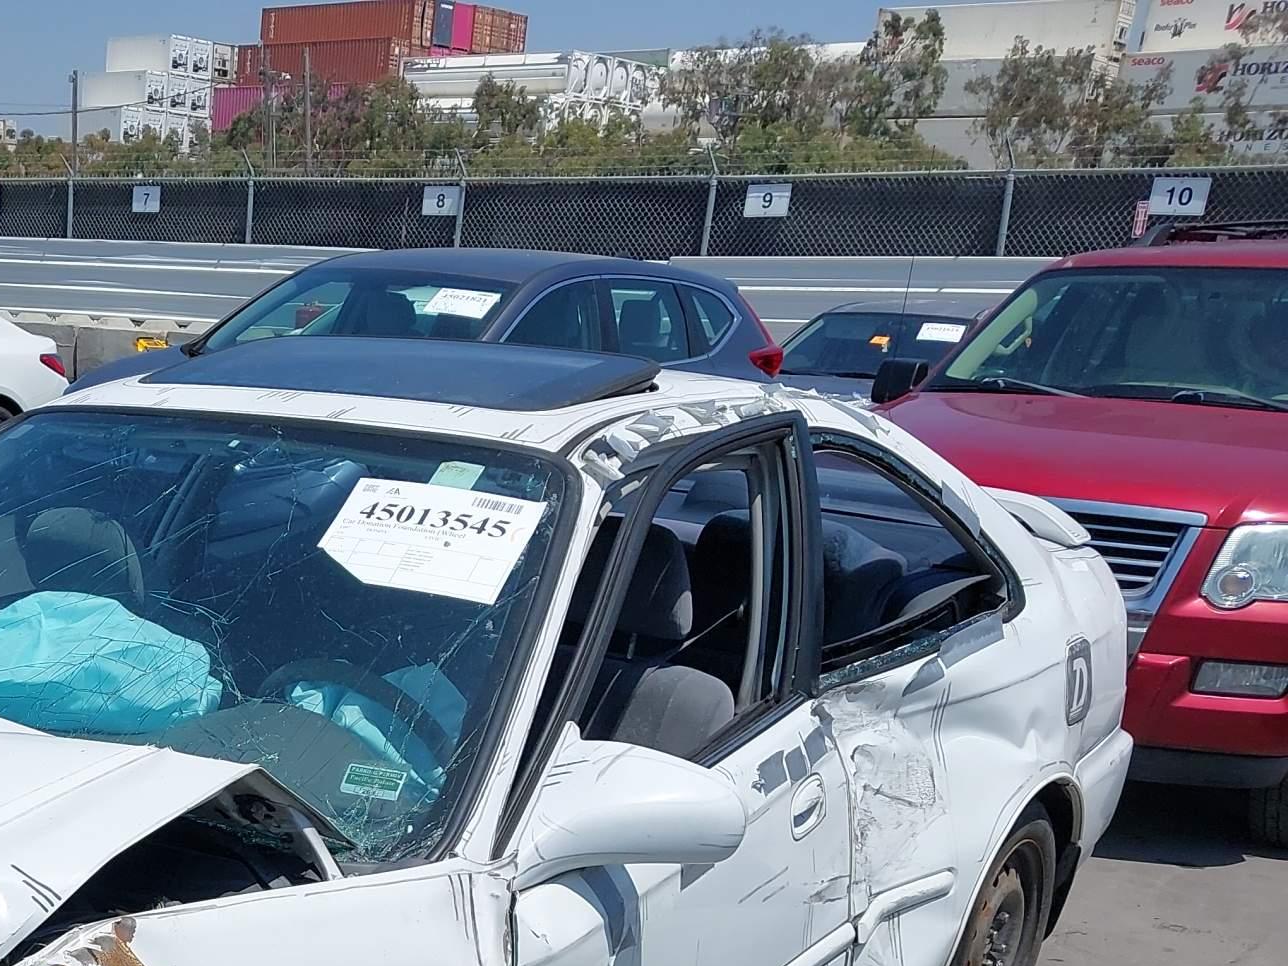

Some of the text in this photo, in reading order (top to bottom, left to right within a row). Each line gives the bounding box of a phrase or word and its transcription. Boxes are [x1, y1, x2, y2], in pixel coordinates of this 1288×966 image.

[1131, 57, 1165, 66] seaco
[143, 192, 150, 206] 7
[436, 193, 446, 208] 8
[761, 192, 773, 208] 9
[1166, 186, 1194, 206] 10
[359, 501, 512, 538] 45013545
